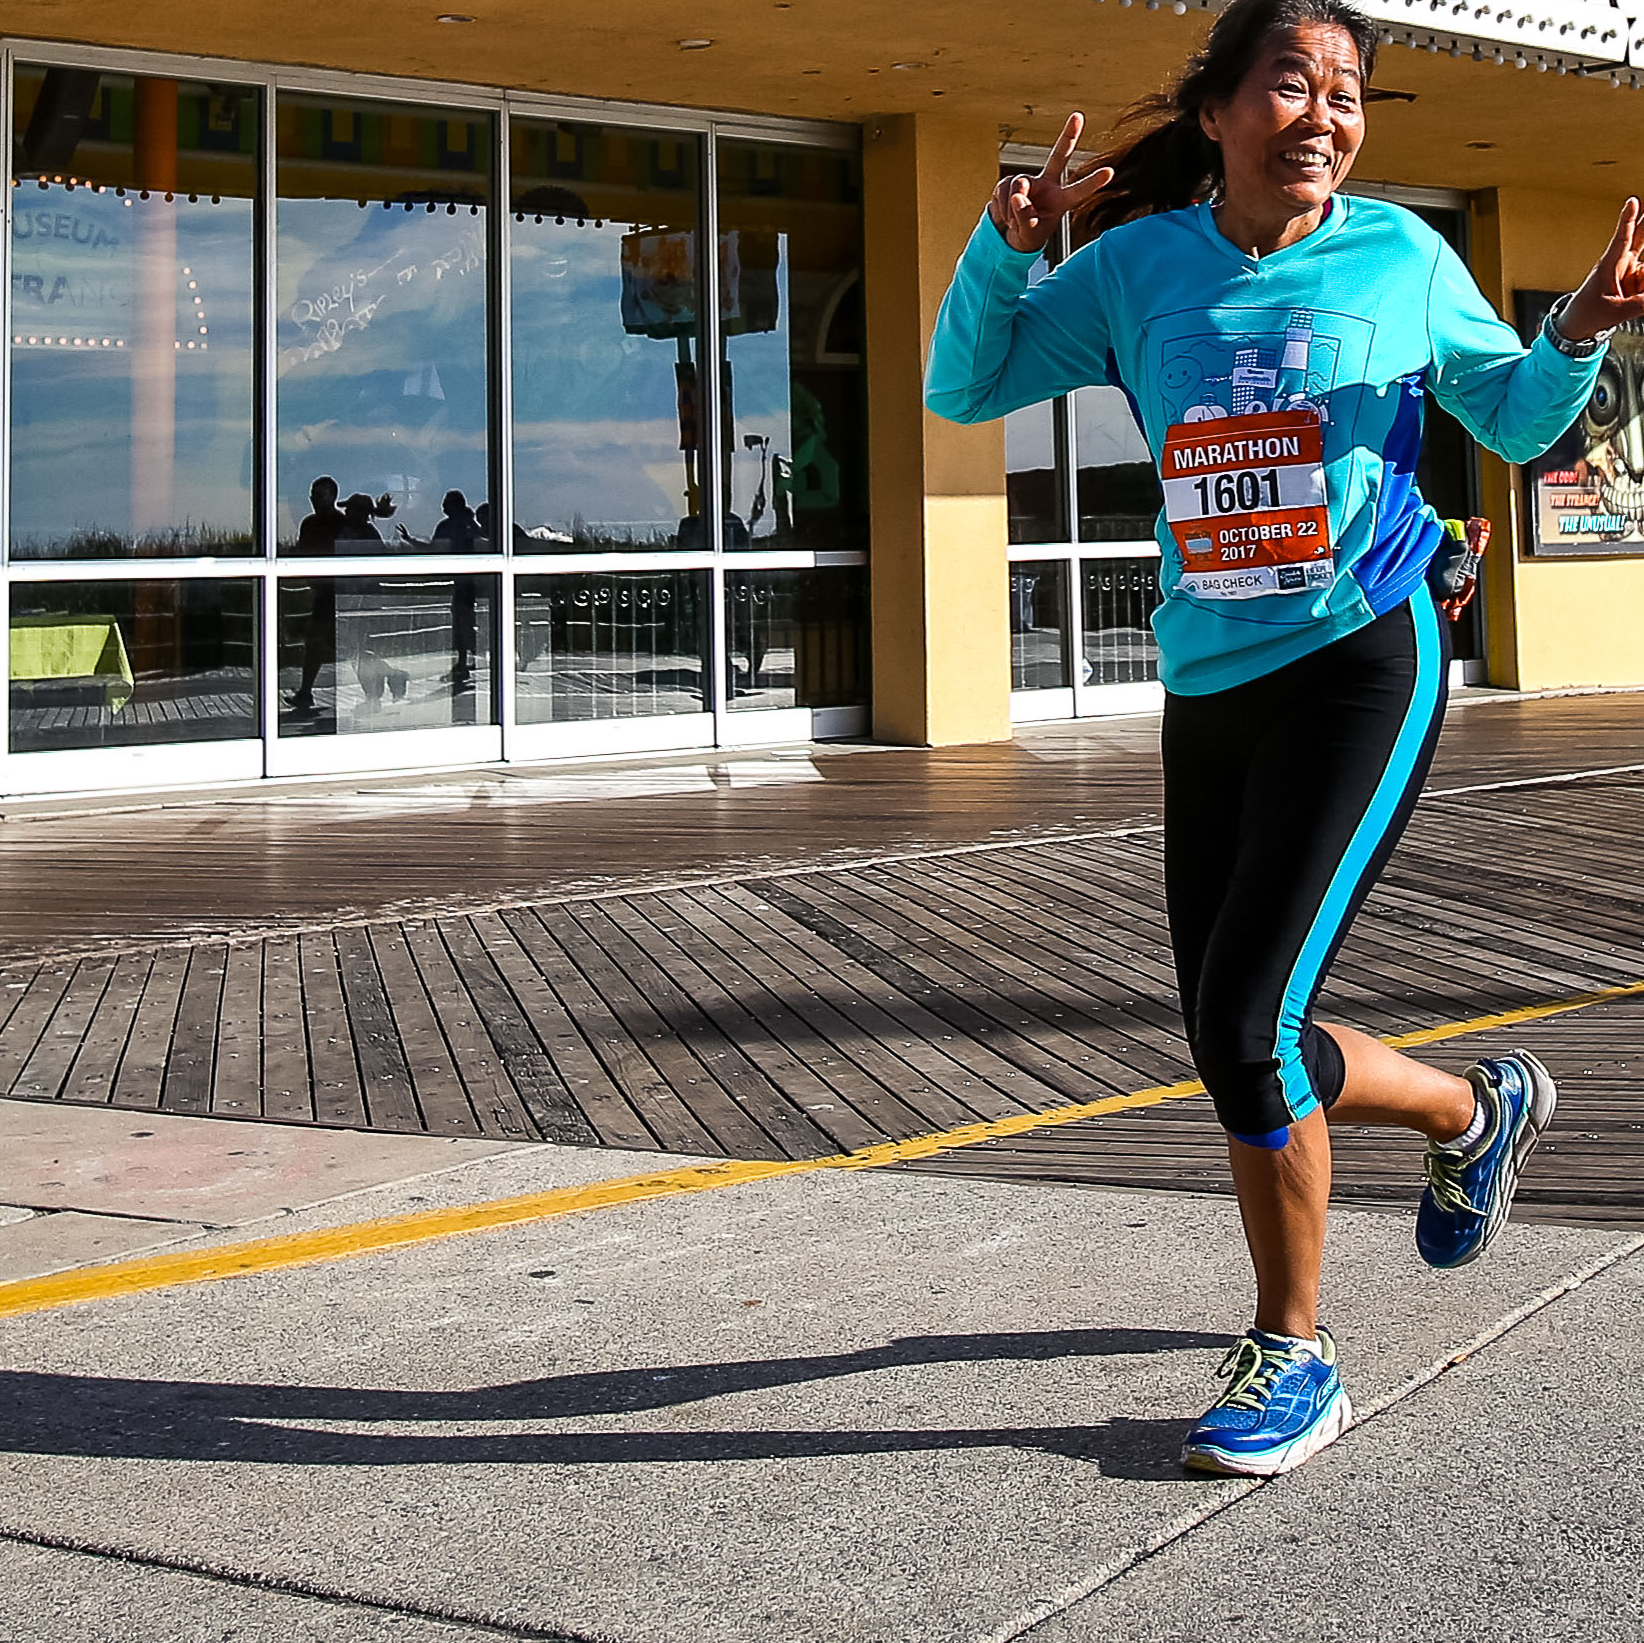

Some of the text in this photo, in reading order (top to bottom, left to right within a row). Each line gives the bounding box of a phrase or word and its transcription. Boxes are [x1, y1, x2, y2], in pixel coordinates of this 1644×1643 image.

[1173, 436, 1300, 470] MARATHON
[1194, 468, 1280, 516] 1601
[1219, 522, 1293, 544] OCTOBER
[1296, 521, 1318, 536] 22
[1558, 515, 1579, 533] THE
[1220, 544, 1257, 561] 2017
[1202, 577, 1221, 590] BAG
[1223, 575, 1264, 589] CHECK
